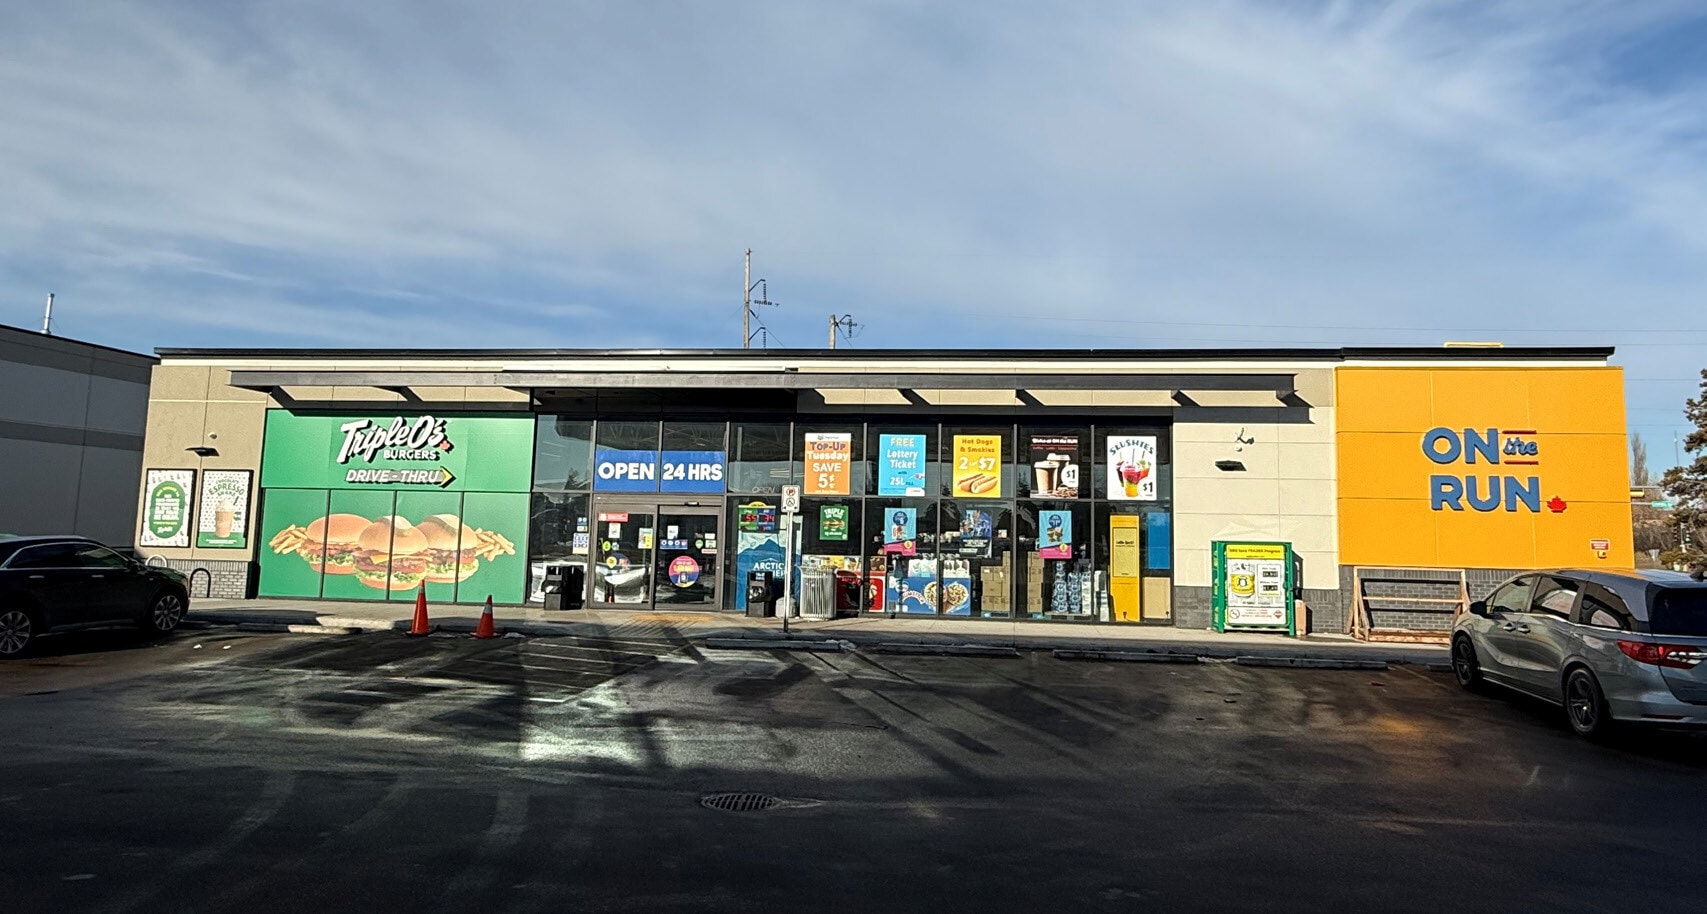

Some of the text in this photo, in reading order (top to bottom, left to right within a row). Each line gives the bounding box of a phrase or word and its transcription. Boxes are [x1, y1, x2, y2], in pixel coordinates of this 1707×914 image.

[890, 437, 915, 448] FREE
[1109, 439, 1154, 456] SLUSHIES
[1422, 427, 1538, 464] ON the
[383, 449, 437, 460] BURGERS
[807, 450, 849, 462] Tuesday
[886, 449, 918, 461] Lottery
[812, 462, 842, 472] SAVE
[890, 459, 917, 469] Ticket
[959, 456, 969, 470] 2
[978, 456, 996, 471] $7
[598, 462, 723, 481] OPEN 24 HRS
[1066, 469, 1076, 480] $1
[208, 482, 245, 496] ESPRESSO
[752, 486, 775, 494] OPEN
[1142, 482, 1153, 493] $1
[1430, 475, 1541, 513] RUN
[753, 561, 785, 570] ARCTIC
